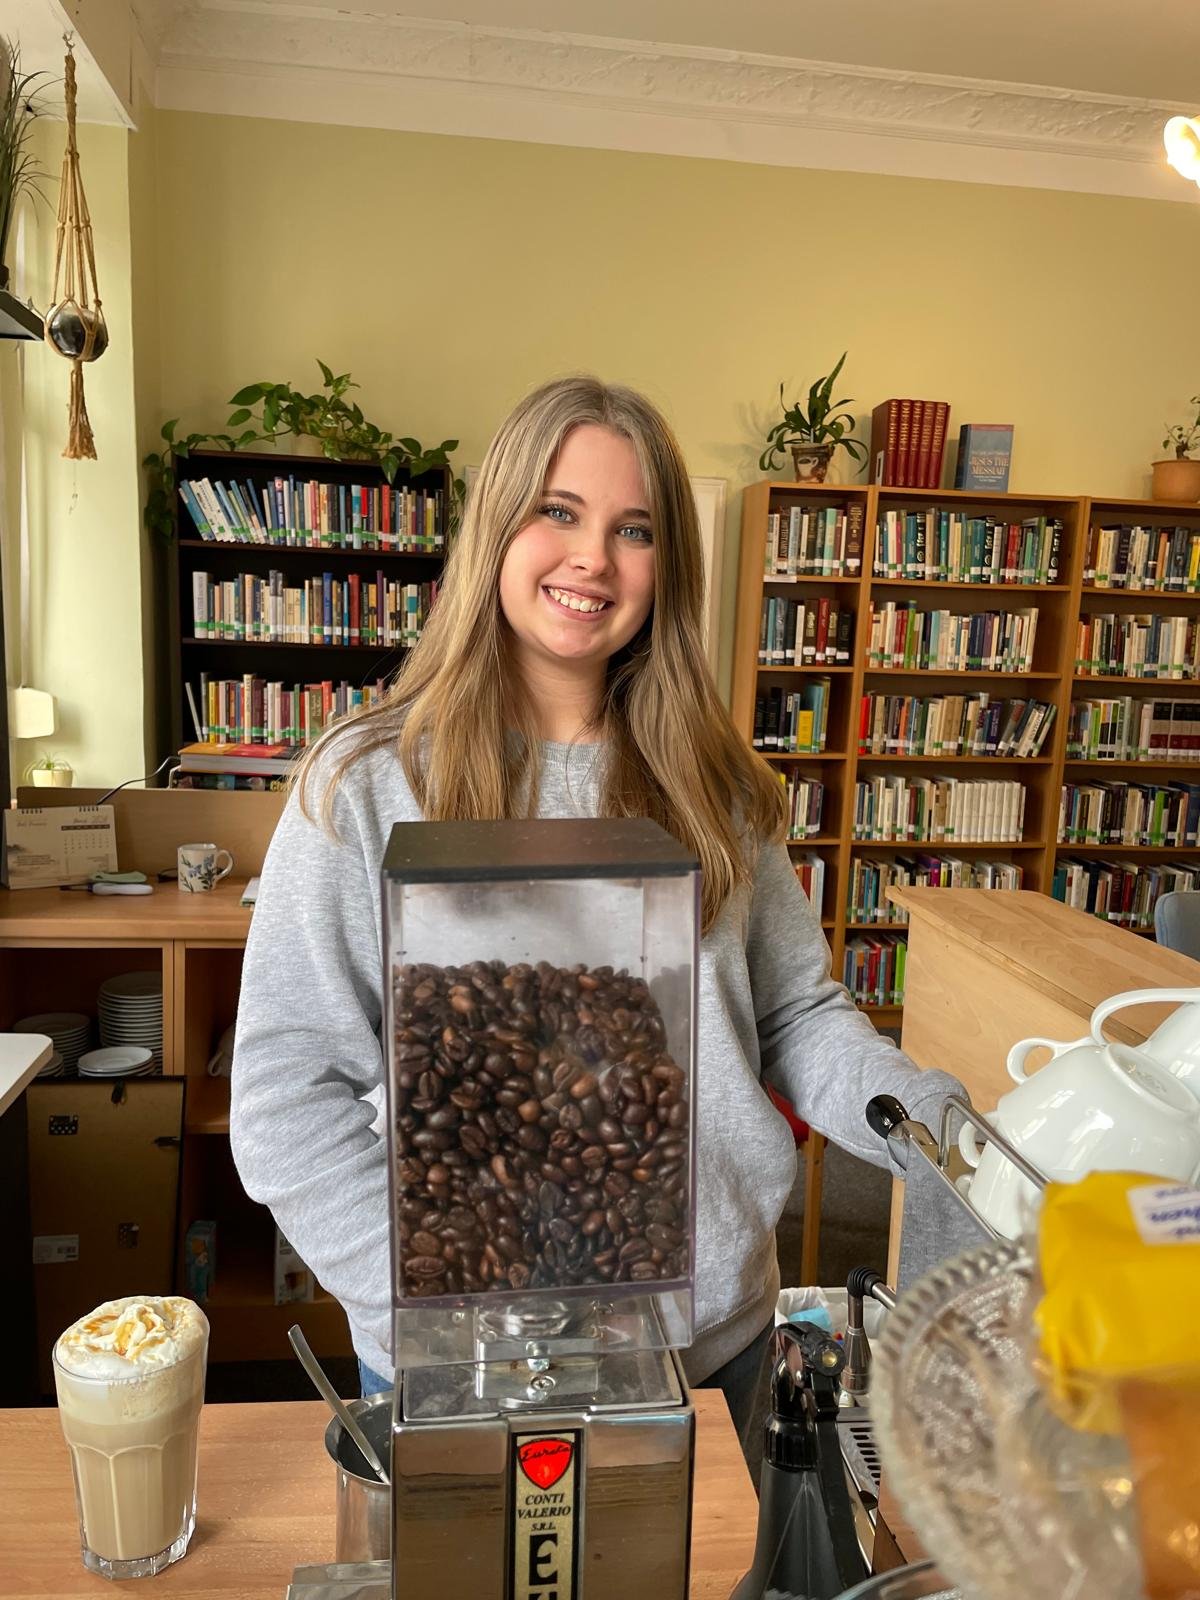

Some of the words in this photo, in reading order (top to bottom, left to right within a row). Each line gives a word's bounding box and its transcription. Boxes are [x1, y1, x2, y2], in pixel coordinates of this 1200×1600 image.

[994, 456, 1009, 466] THE
[525, 1493, 565, 1505] CONTI
[518, 1506, 571, 1519] VALERIO
